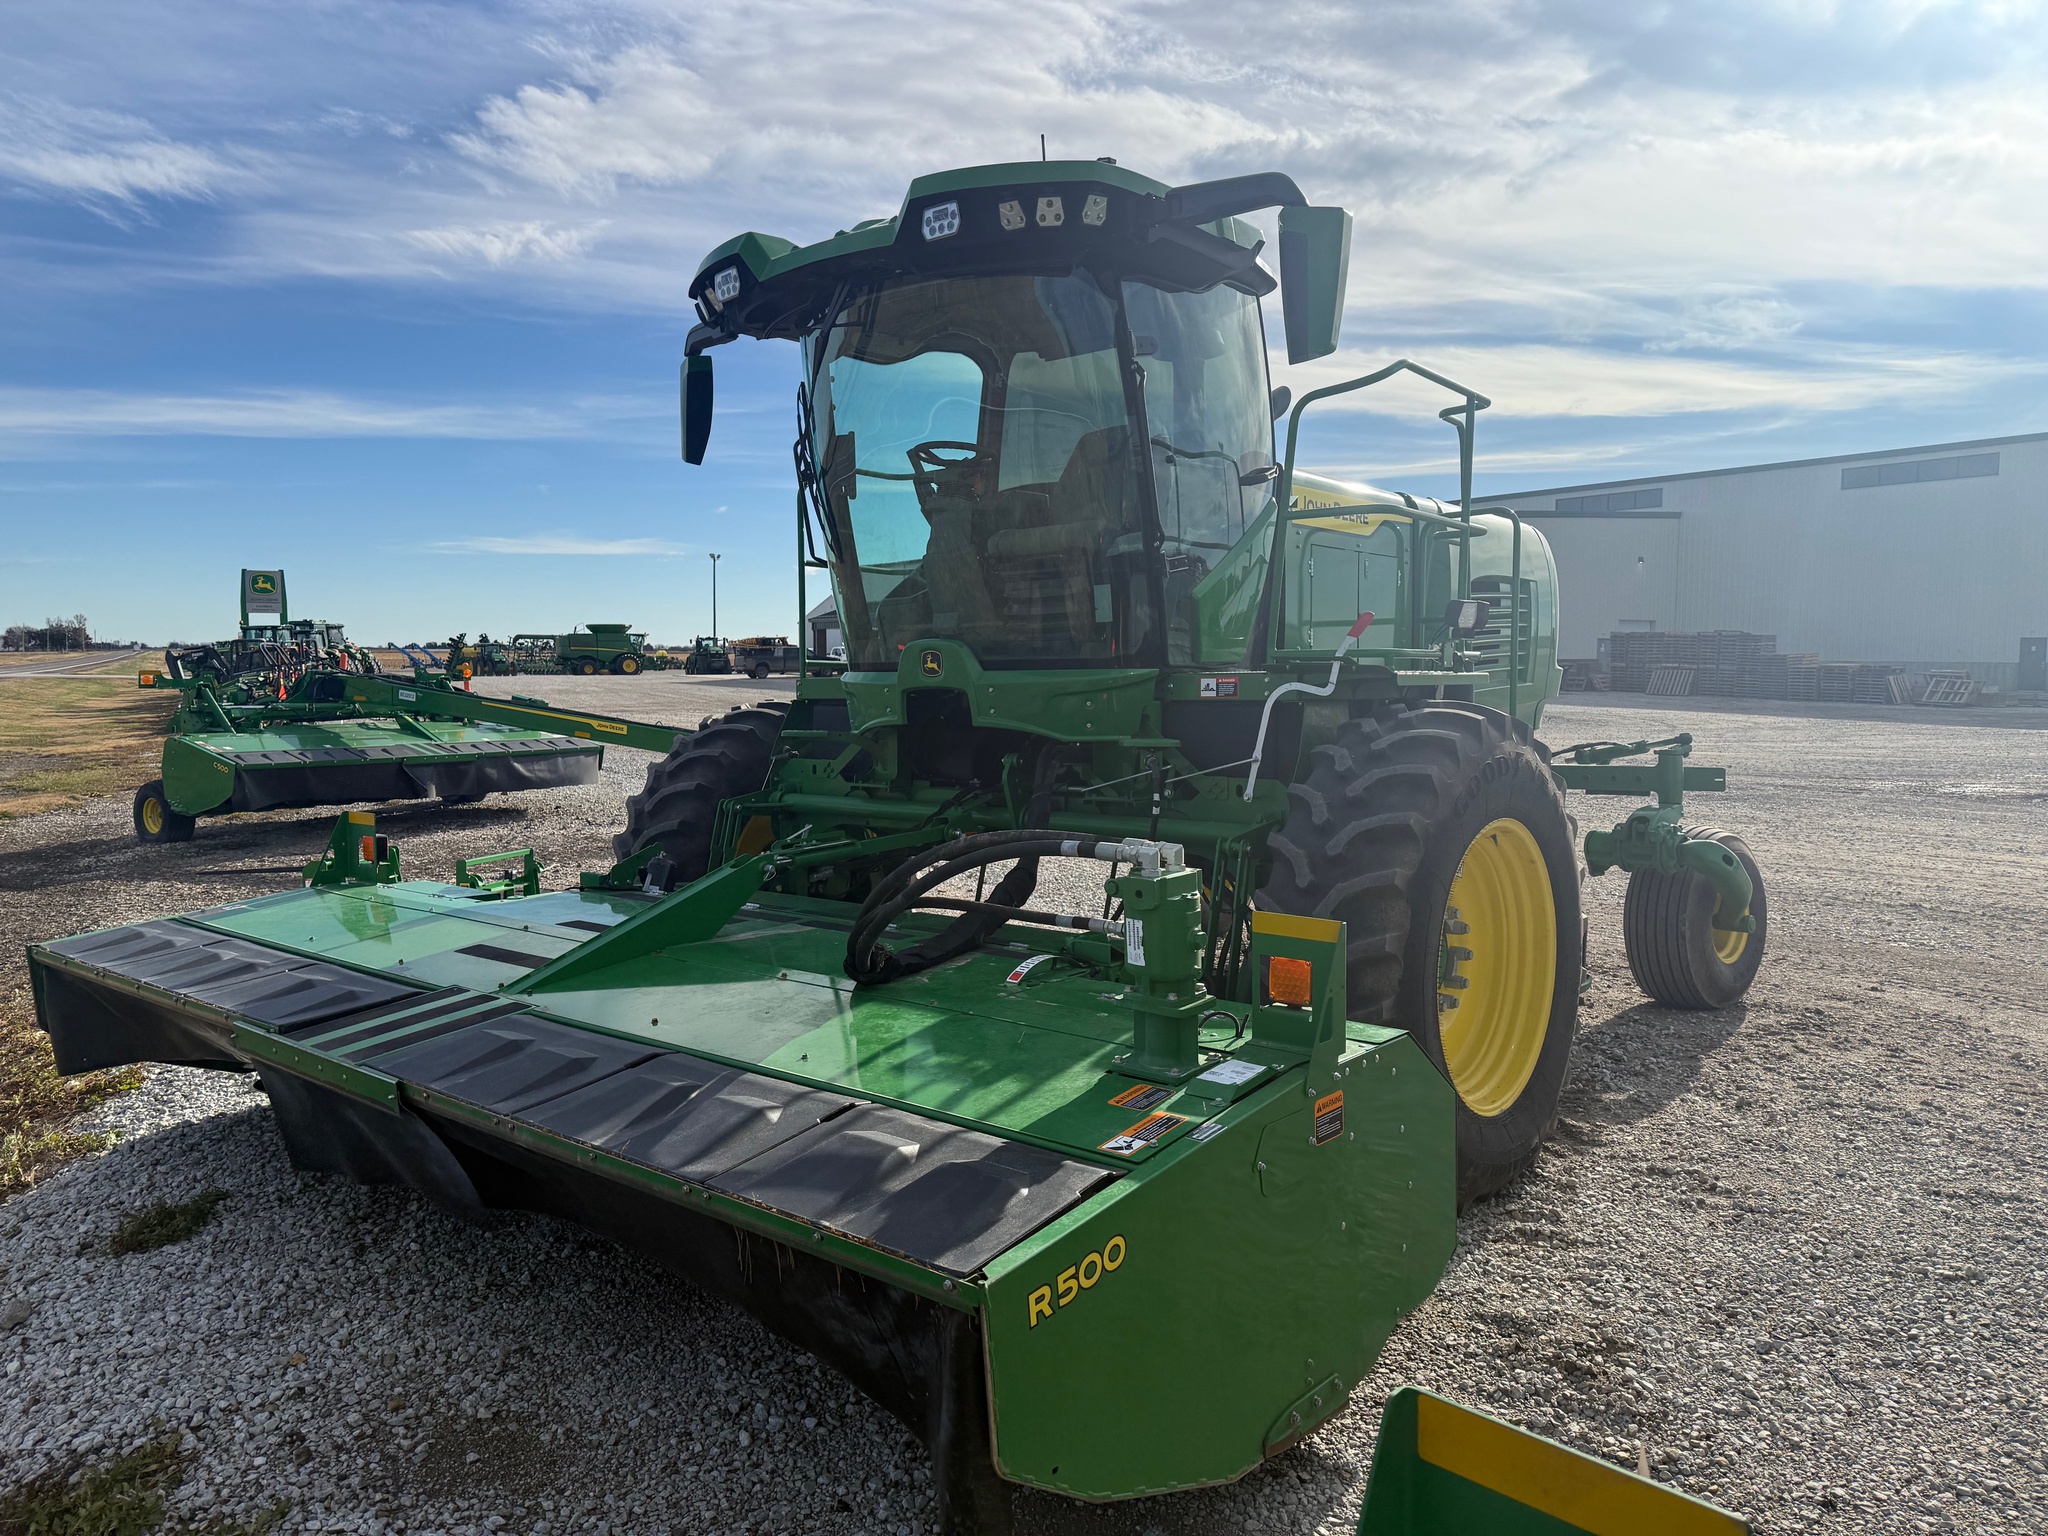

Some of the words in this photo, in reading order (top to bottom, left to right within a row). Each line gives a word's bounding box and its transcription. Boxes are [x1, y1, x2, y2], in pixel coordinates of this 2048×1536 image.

[596, 722, 609, 730] JOHN
[609, 724, 625, 732] DEERE
[213, 761, 229, 774] C500
[1321, 1094, 1343, 1111] WARNING
